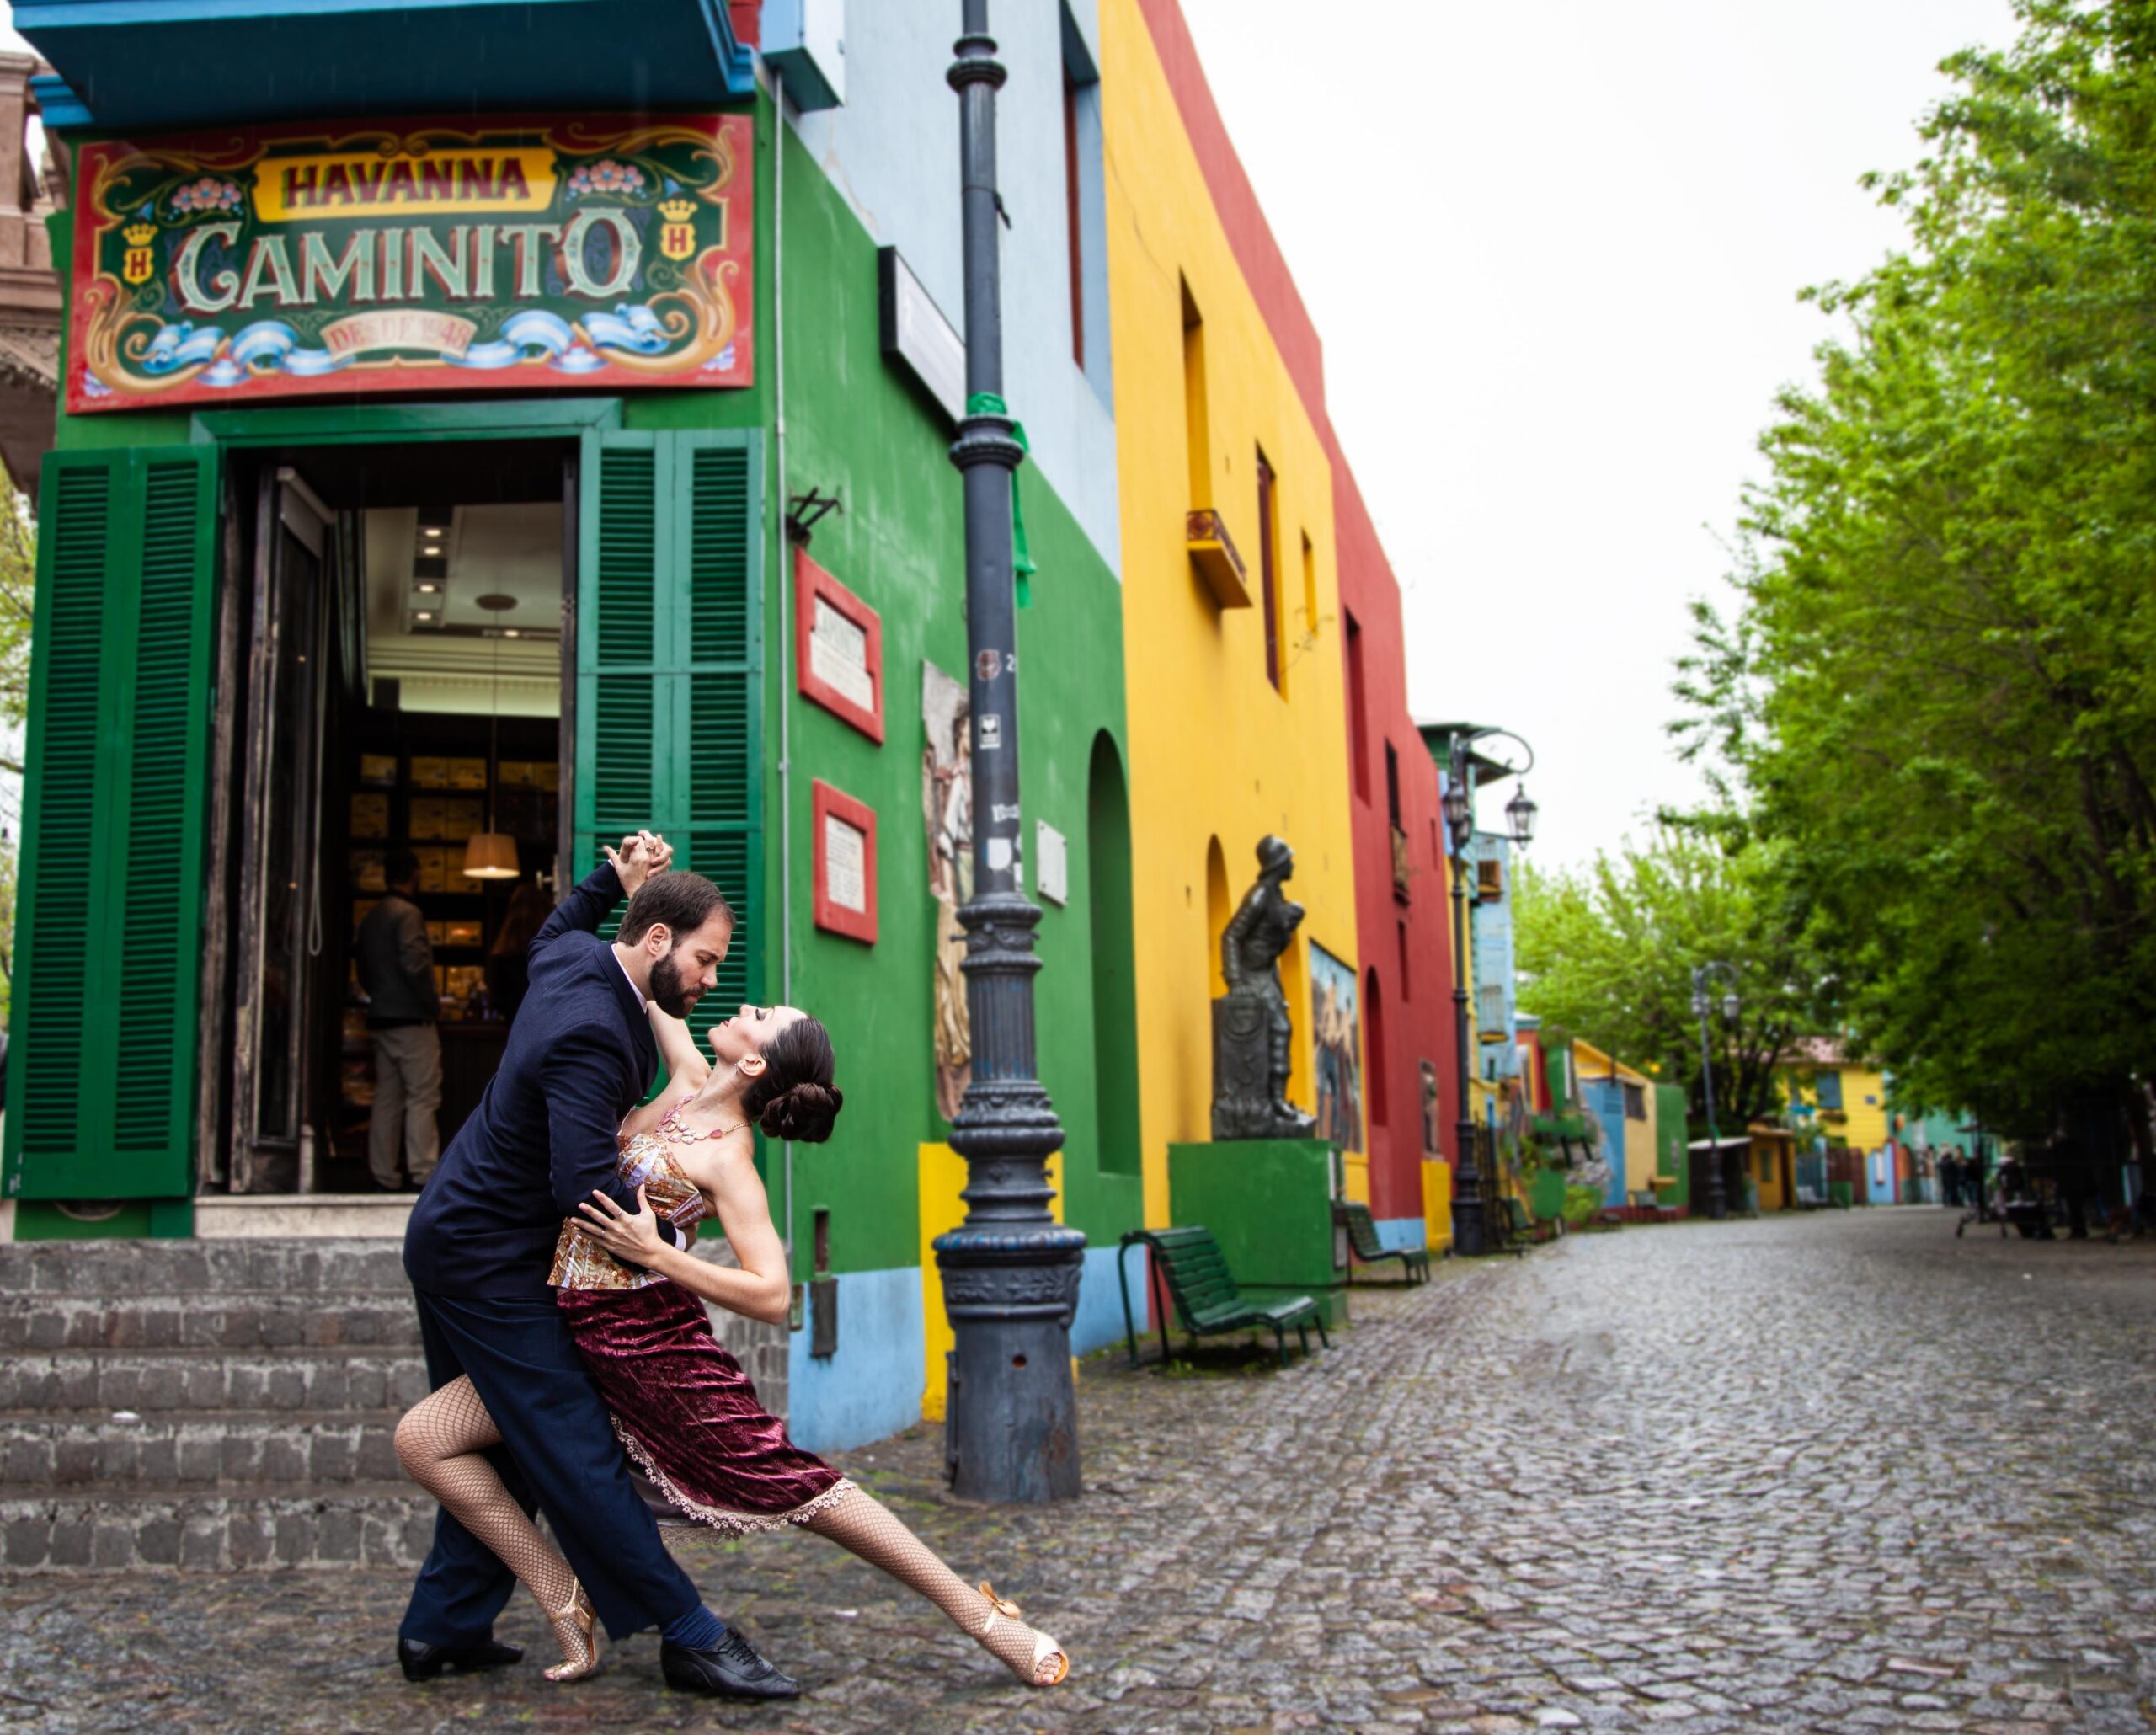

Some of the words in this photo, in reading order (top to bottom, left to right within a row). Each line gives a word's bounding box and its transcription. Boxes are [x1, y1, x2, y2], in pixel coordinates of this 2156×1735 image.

[283, 157, 531, 208] HAVANNA
[670, 227, 686, 252] H
[130, 250, 147, 276] H
[170, 207, 643, 314] CAMINITO
